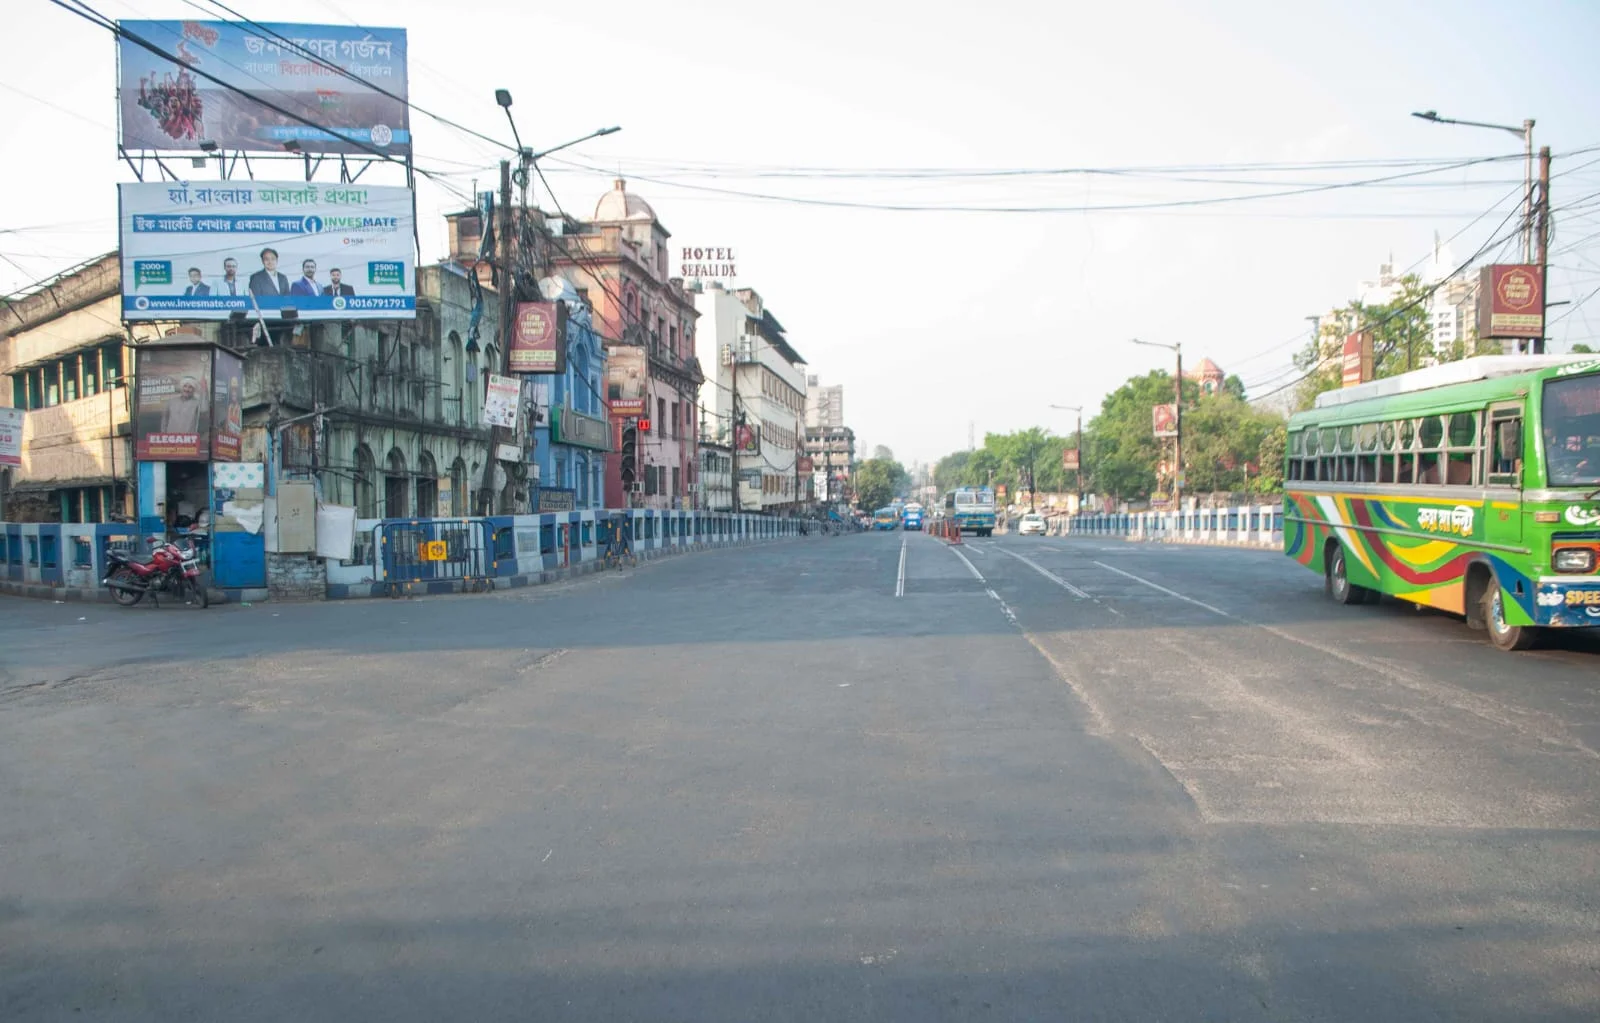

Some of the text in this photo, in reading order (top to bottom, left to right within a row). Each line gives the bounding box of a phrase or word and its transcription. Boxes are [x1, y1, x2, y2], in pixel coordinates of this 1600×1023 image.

[340, 34, 392, 60] গর্জন
[195, 188, 253, 205] বাংলায়
[257, 184, 319, 205] আমরাই
[325, 188, 368, 205] প্রথম!
[324, 217, 397, 227] INVESMATE
[683, 248, 735, 260] HOTEL
[374, 263, 398, 271] 2500+
[681, 263, 737, 277] SEFALI DX
[151, 298, 245, 309] www.invesmate.com
[349, 298, 406, 308] 9016791791
